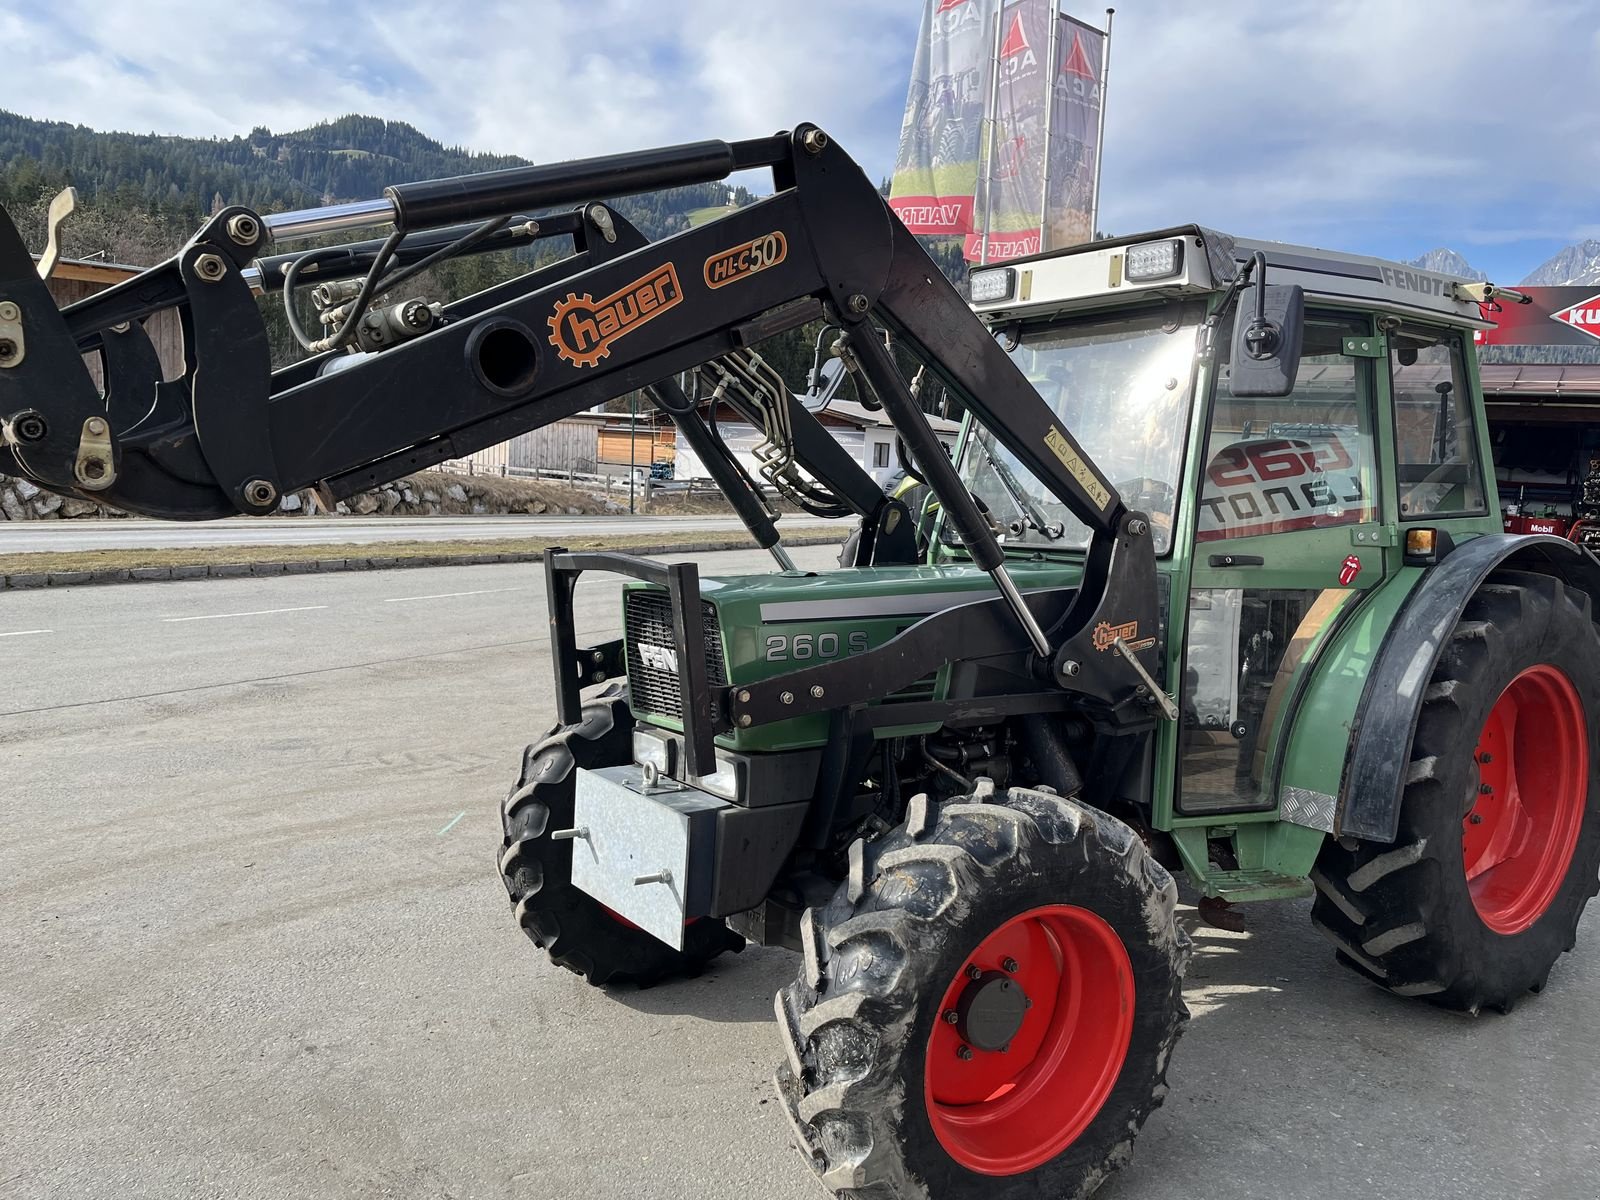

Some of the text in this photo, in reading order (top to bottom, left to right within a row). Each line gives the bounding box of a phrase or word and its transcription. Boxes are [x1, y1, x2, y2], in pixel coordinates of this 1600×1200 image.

[1381, 265, 1444, 297] FENDT
[1530, 524, 1554, 533] Mobil
[766, 631, 869, 661] 260 S
